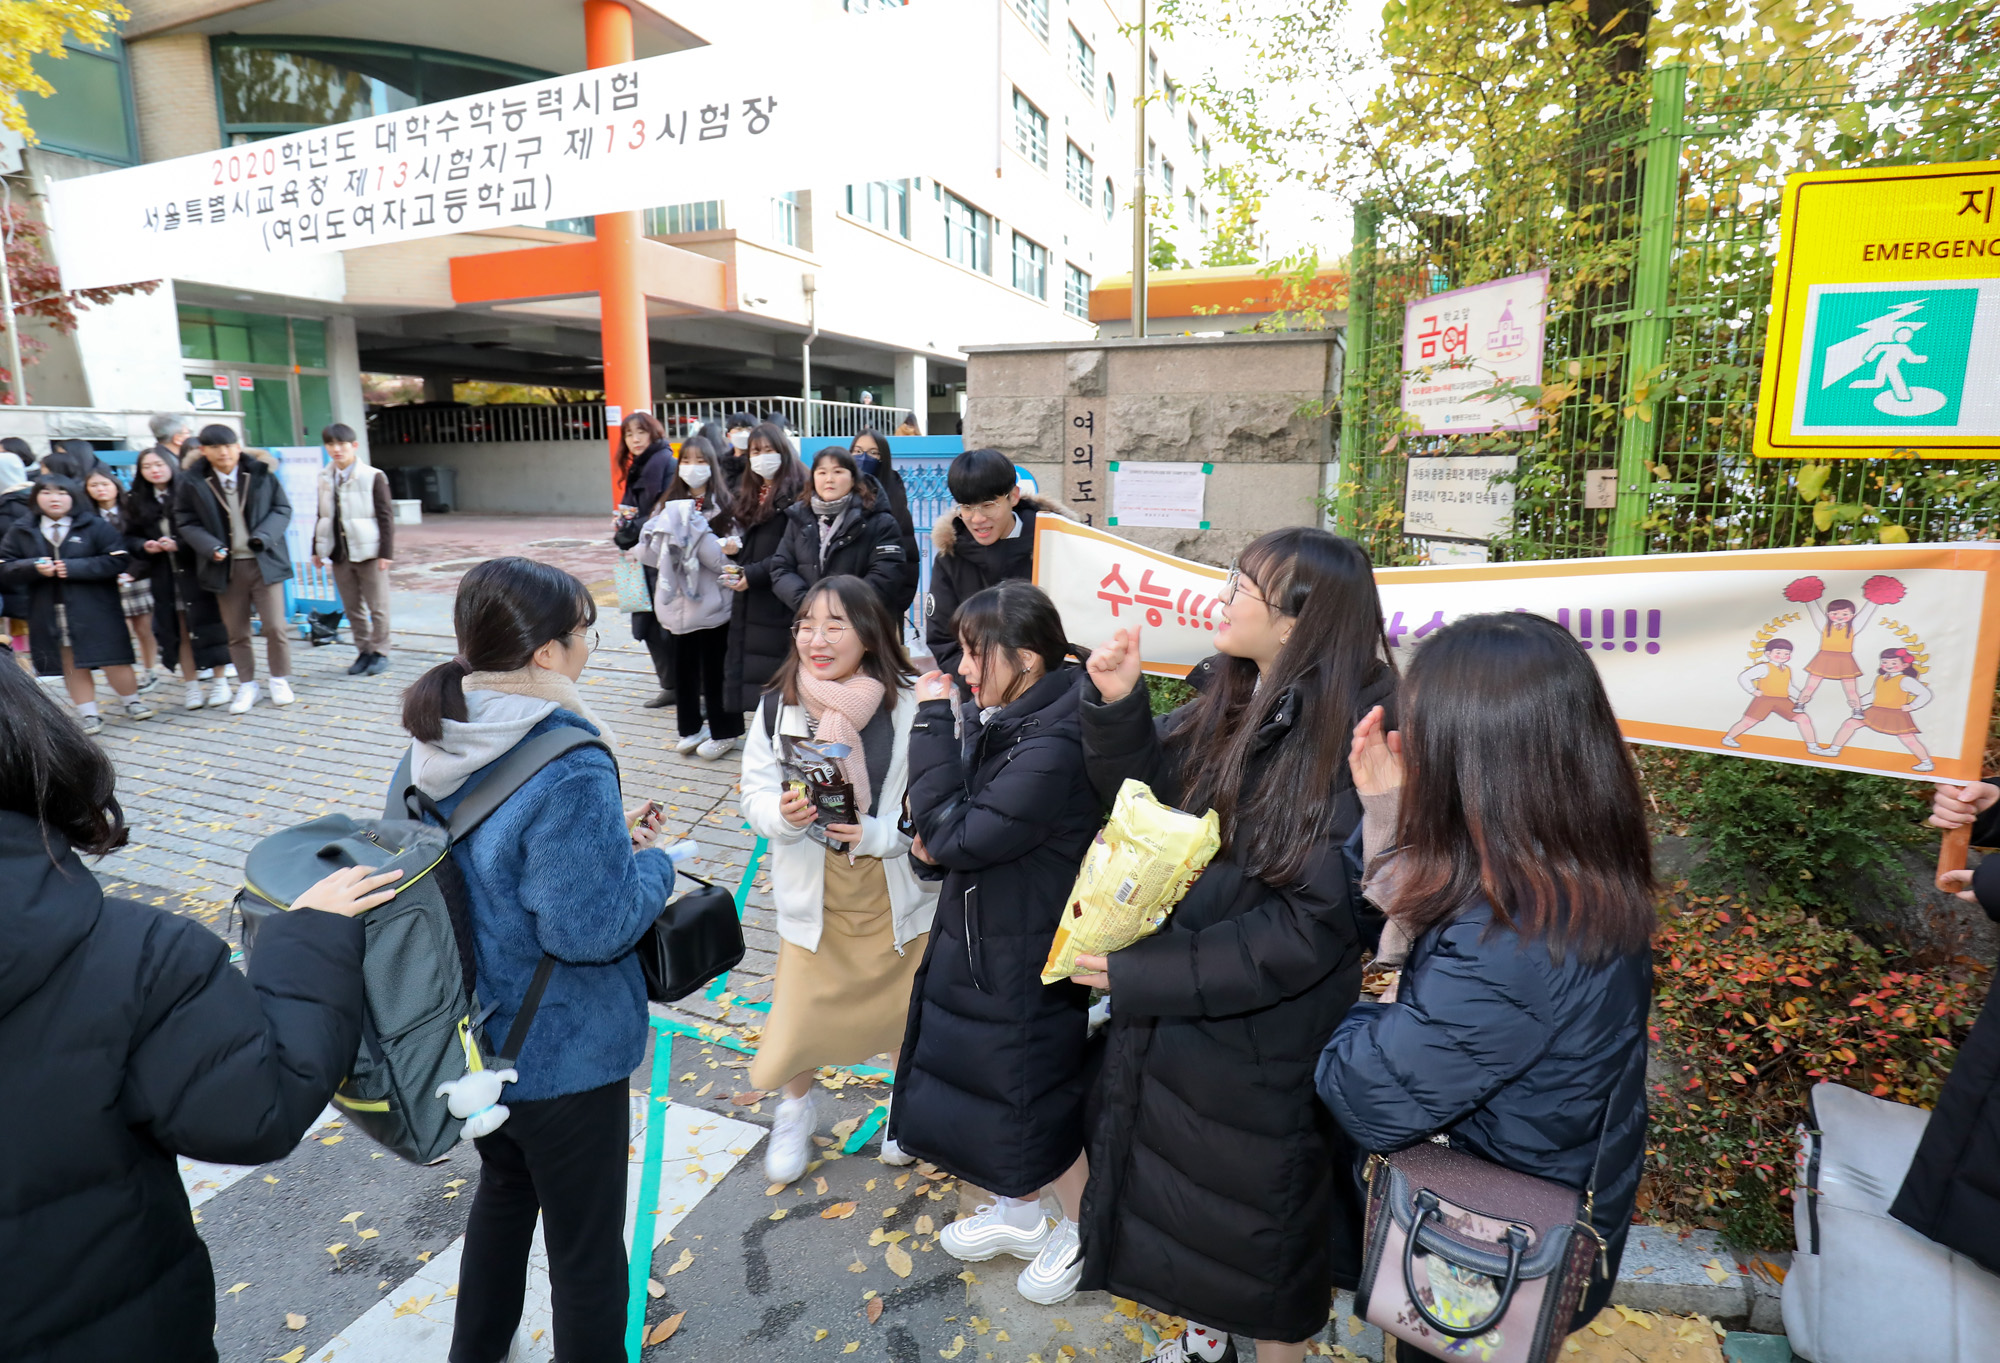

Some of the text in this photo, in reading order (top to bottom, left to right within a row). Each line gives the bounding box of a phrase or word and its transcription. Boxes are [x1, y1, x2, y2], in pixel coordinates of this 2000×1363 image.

[212, 71, 640, 187] 2020학년도 대학수학능력시험
[143, 95, 778, 233] 서울특별시교육청 제13시험지구 제13시험장
[262, 173, 553, 252] (여의도여자고등학교)
[1956, 186, 1995, 224] 지
[1417, 315, 1468, 370] 금연
[1500, 491, 1509, 505] 수
[1097, 563, 1221, 631] 수능!!!
